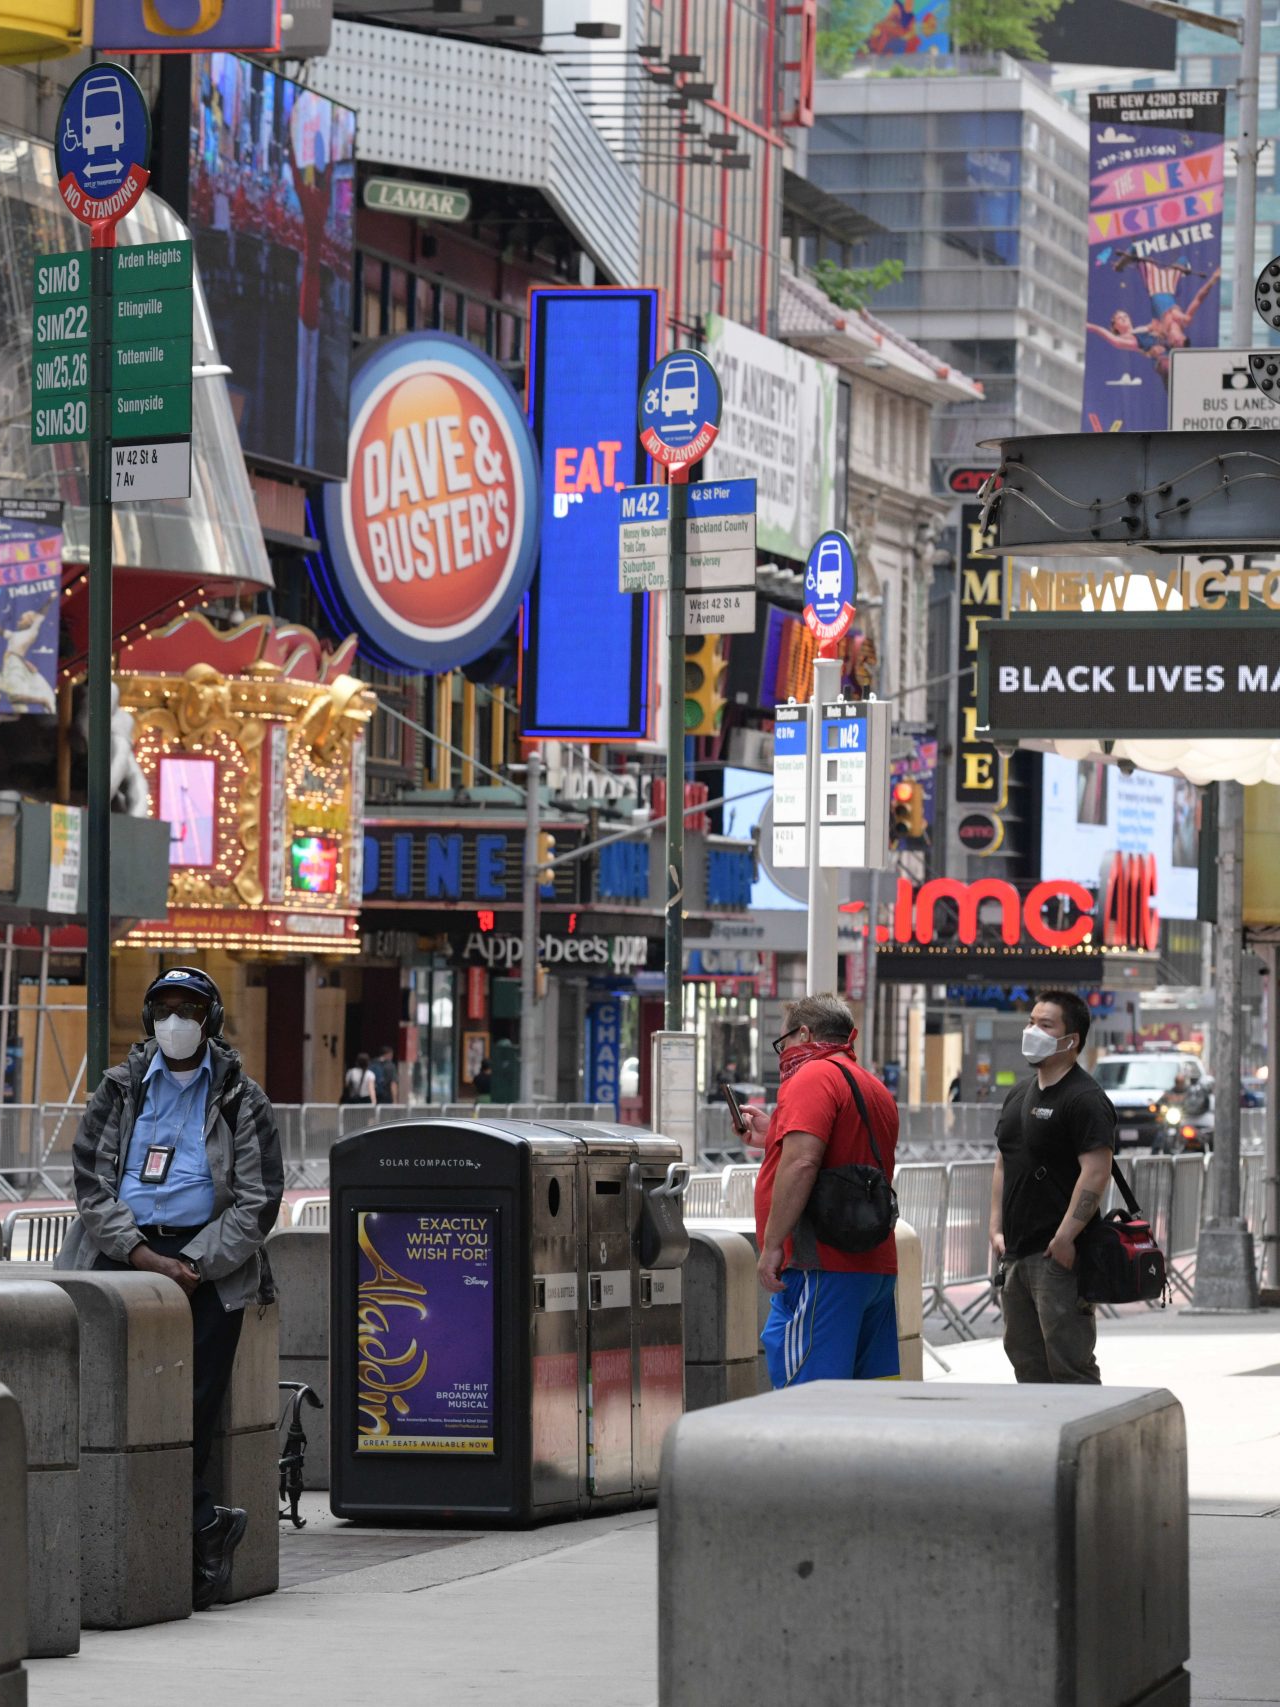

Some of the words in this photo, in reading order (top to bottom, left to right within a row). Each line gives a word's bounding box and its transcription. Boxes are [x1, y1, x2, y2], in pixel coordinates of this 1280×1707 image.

[1096, 95, 1117, 109] THE
[1119, 94, 1145, 108] NEW
[1146, 93, 1176, 107] 42ND
[1178, 91, 1219, 105] STREET
[1121, 108, 1194, 121] CELEBRATES
[1097, 149, 1132, 170] 2019-20
[1133, 144, 1177, 159] SEASON
[1114, 168, 1136, 199] THE
[1142, 155, 1214, 196] NEW
[64, 183, 81, 209] NO
[82, 175, 139, 219] STANDING
[379, 185, 455, 214] LAMAR
[1094, 191, 1216, 239] VICTORY
[1132, 222, 1215, 258] THEATER
[118, 253, 144, 269] Arden
[147, 248, 181, 268] Heights
[38, 258, 80, 295] SIM8
[118, 299, 163, 319] Eltingville
[37, 305, 88, 342] SIM22
[117, 347, 164, 366] Tottenville
[36, 353, 88, 391] SIM25,26
[117, 395, 164, 415] Sunnyside
[740, 361, 798, 431] ANXIETY?
[1203, 398, 1228, 411] BUS
[1234, 397, 1275, 411] LANES
[36, 401, 87, 437] SIM30
[1183, 417, 1224, 430] PHOTO
[647, 435, 661, 454] NO
[662, 431, 711, 461] STANDING
[116, 451, 124, 466] W
[127, 450, 137, 465] 42
[140, 450, 148, 465] St
[151, 449, 158, 464] &
[363, 415, 473, 517] DAVE
[468, 415, 506, 485] &
[554, 441, 625, 494] EAT.
[116, 472, 121, 487] 7
[124, 472, 135, 487] Av
[691, 490, 701, 500] 42
[703, 489, 712, 500] St
[714, 488, 730, 500] Pier
[622, 492, 660, 518] M42
[367, 488, 509, 583] BUSTER'S
[690, 522, 722, 535] Rockland
[724, 521, 748, 533] County
[623, 560, 656, 573] Suburban
[690, 556, 702, 567] New
[702, 556, 721, 568] Jersey
[648, 573, 667, 587] Corp.
[1019, 570, 1132, 611] NEW
[690, 599, 709, 610] West
[712, 598, 721, 609] 42
[724, 598, 732, 608] St
[734, 598, 740, 608] &
[690, 614, 694, 624] 7
[696, 613, 725, 623] Avenue
[816, 611, 848, 638] STANDING
[999, 665, 1116, 693] BLACK
[1128, 665, 1225, 693] LIVES
[840, 723, 859, 748] M42
[363, 833, 556, 898] DINE
[462, 932, 608, 968] Appebee's
[379, 1159, 409, 1167] SOLAR
[413, 1159, 471, 1167] COMPACTOR
[406, 1233, 452, 1245] WHAT
[456, 1233, 488, 1245] YOU
[406, 1247, 446, 1260] WISH
[462, 1275, 489, 1289] Disney
[653, 1282, 664, 1293] TRASH
[436, 1392, 488, 1400] BROADWAY
[453, 1383, 471, 1391] THE
[474, 1383, 488, 1391] HIT
[448, 1400, 488, 1409] MUSICAL
[363, 1439, 389, 1447] GREAT
[421, 1440, 465, 1448] AVAILABLE
